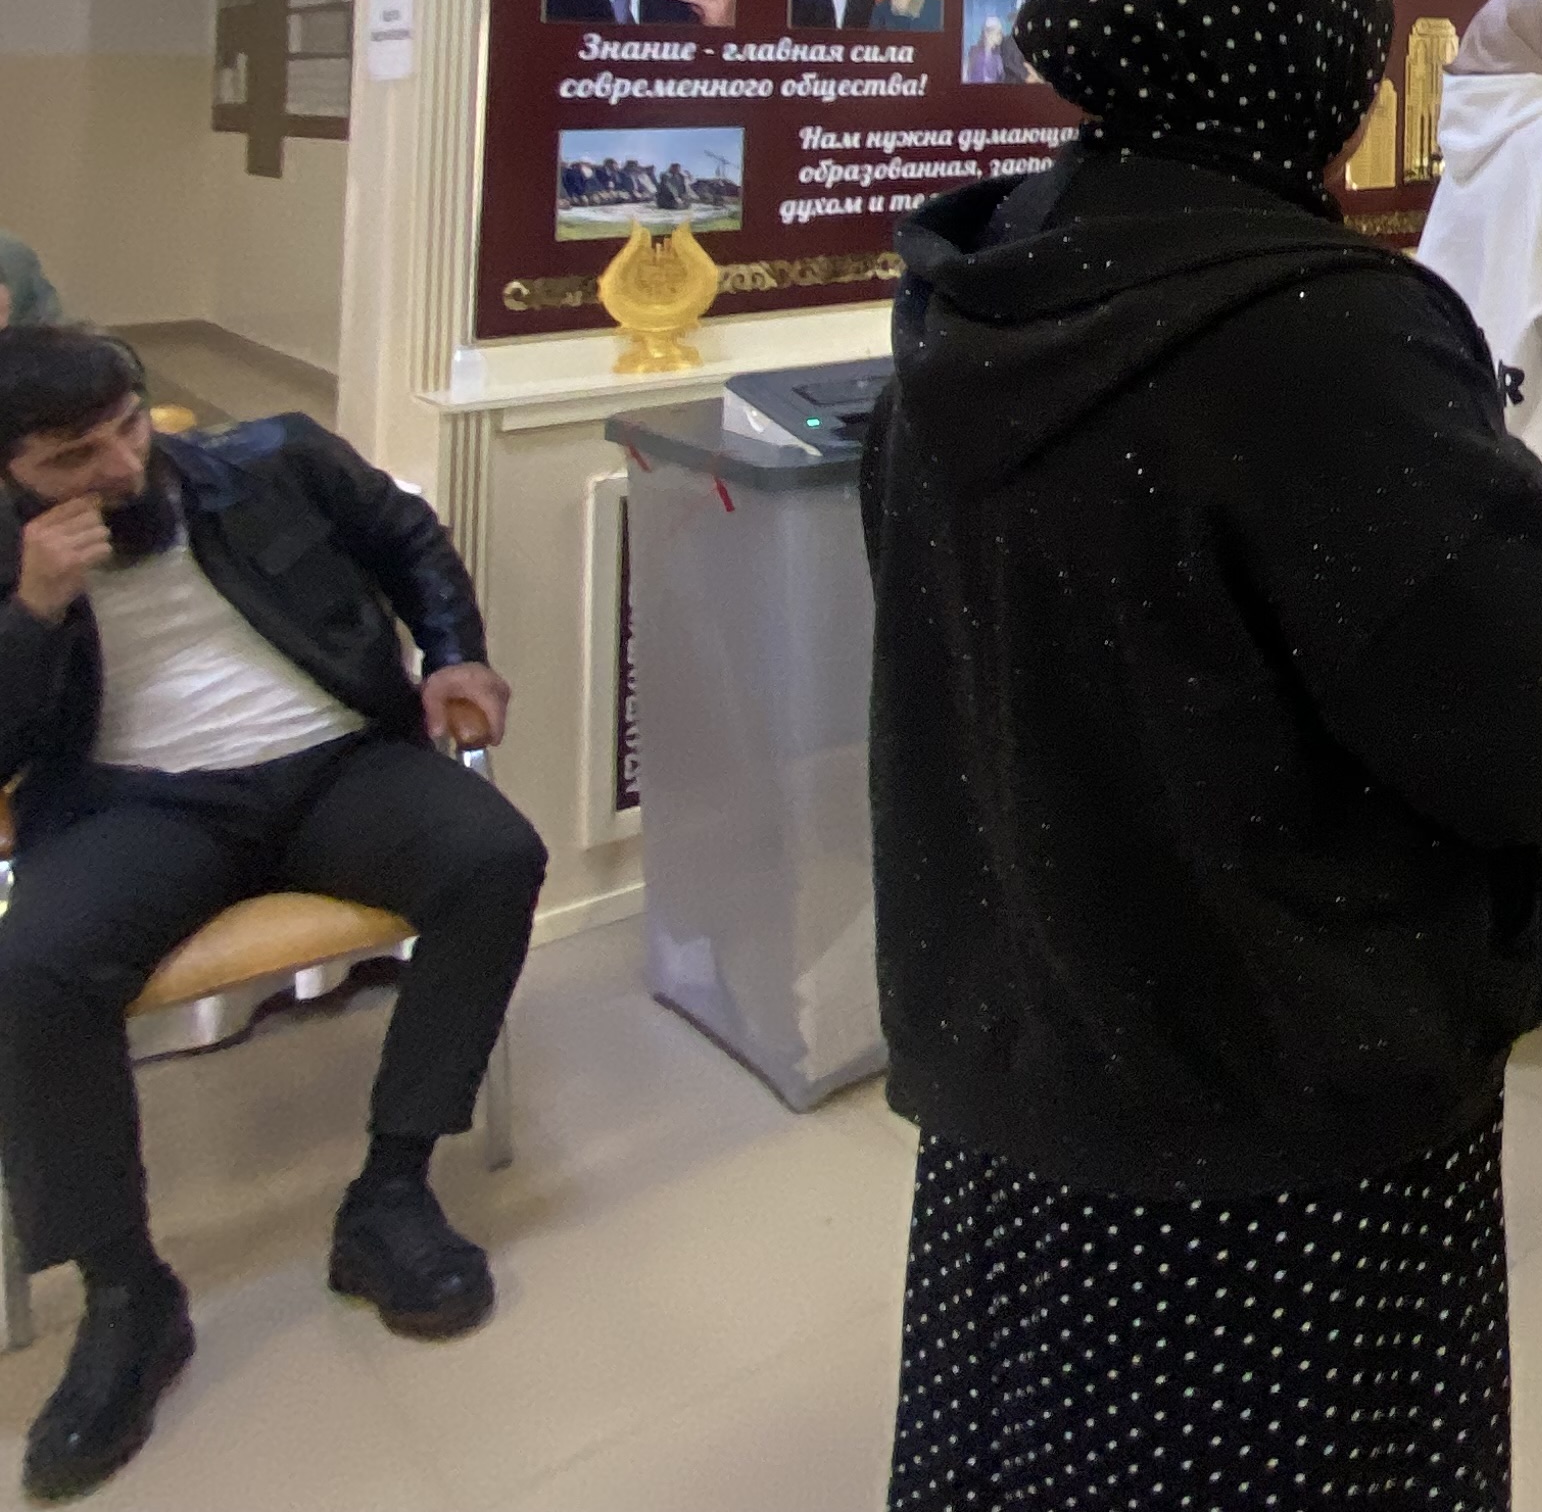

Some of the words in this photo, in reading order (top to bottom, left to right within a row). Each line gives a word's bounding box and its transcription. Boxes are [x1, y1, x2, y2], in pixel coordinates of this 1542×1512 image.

[577, 32, 698, 62] Знание
[721, 36, 846, 64] главная
[849, 43, 916, 65] сила
[558, 70, 775, 106] современного
[779, 72, 929, 104] общества!
[798, 125, 862, 150] Нам
[865, 127, 955, 155] нужна
[798, 156, 984, 189] образованная,
[778, 196, 863, 225] духом
[867, 194, 885, 214] и
[888, 192, 941, 213] те
